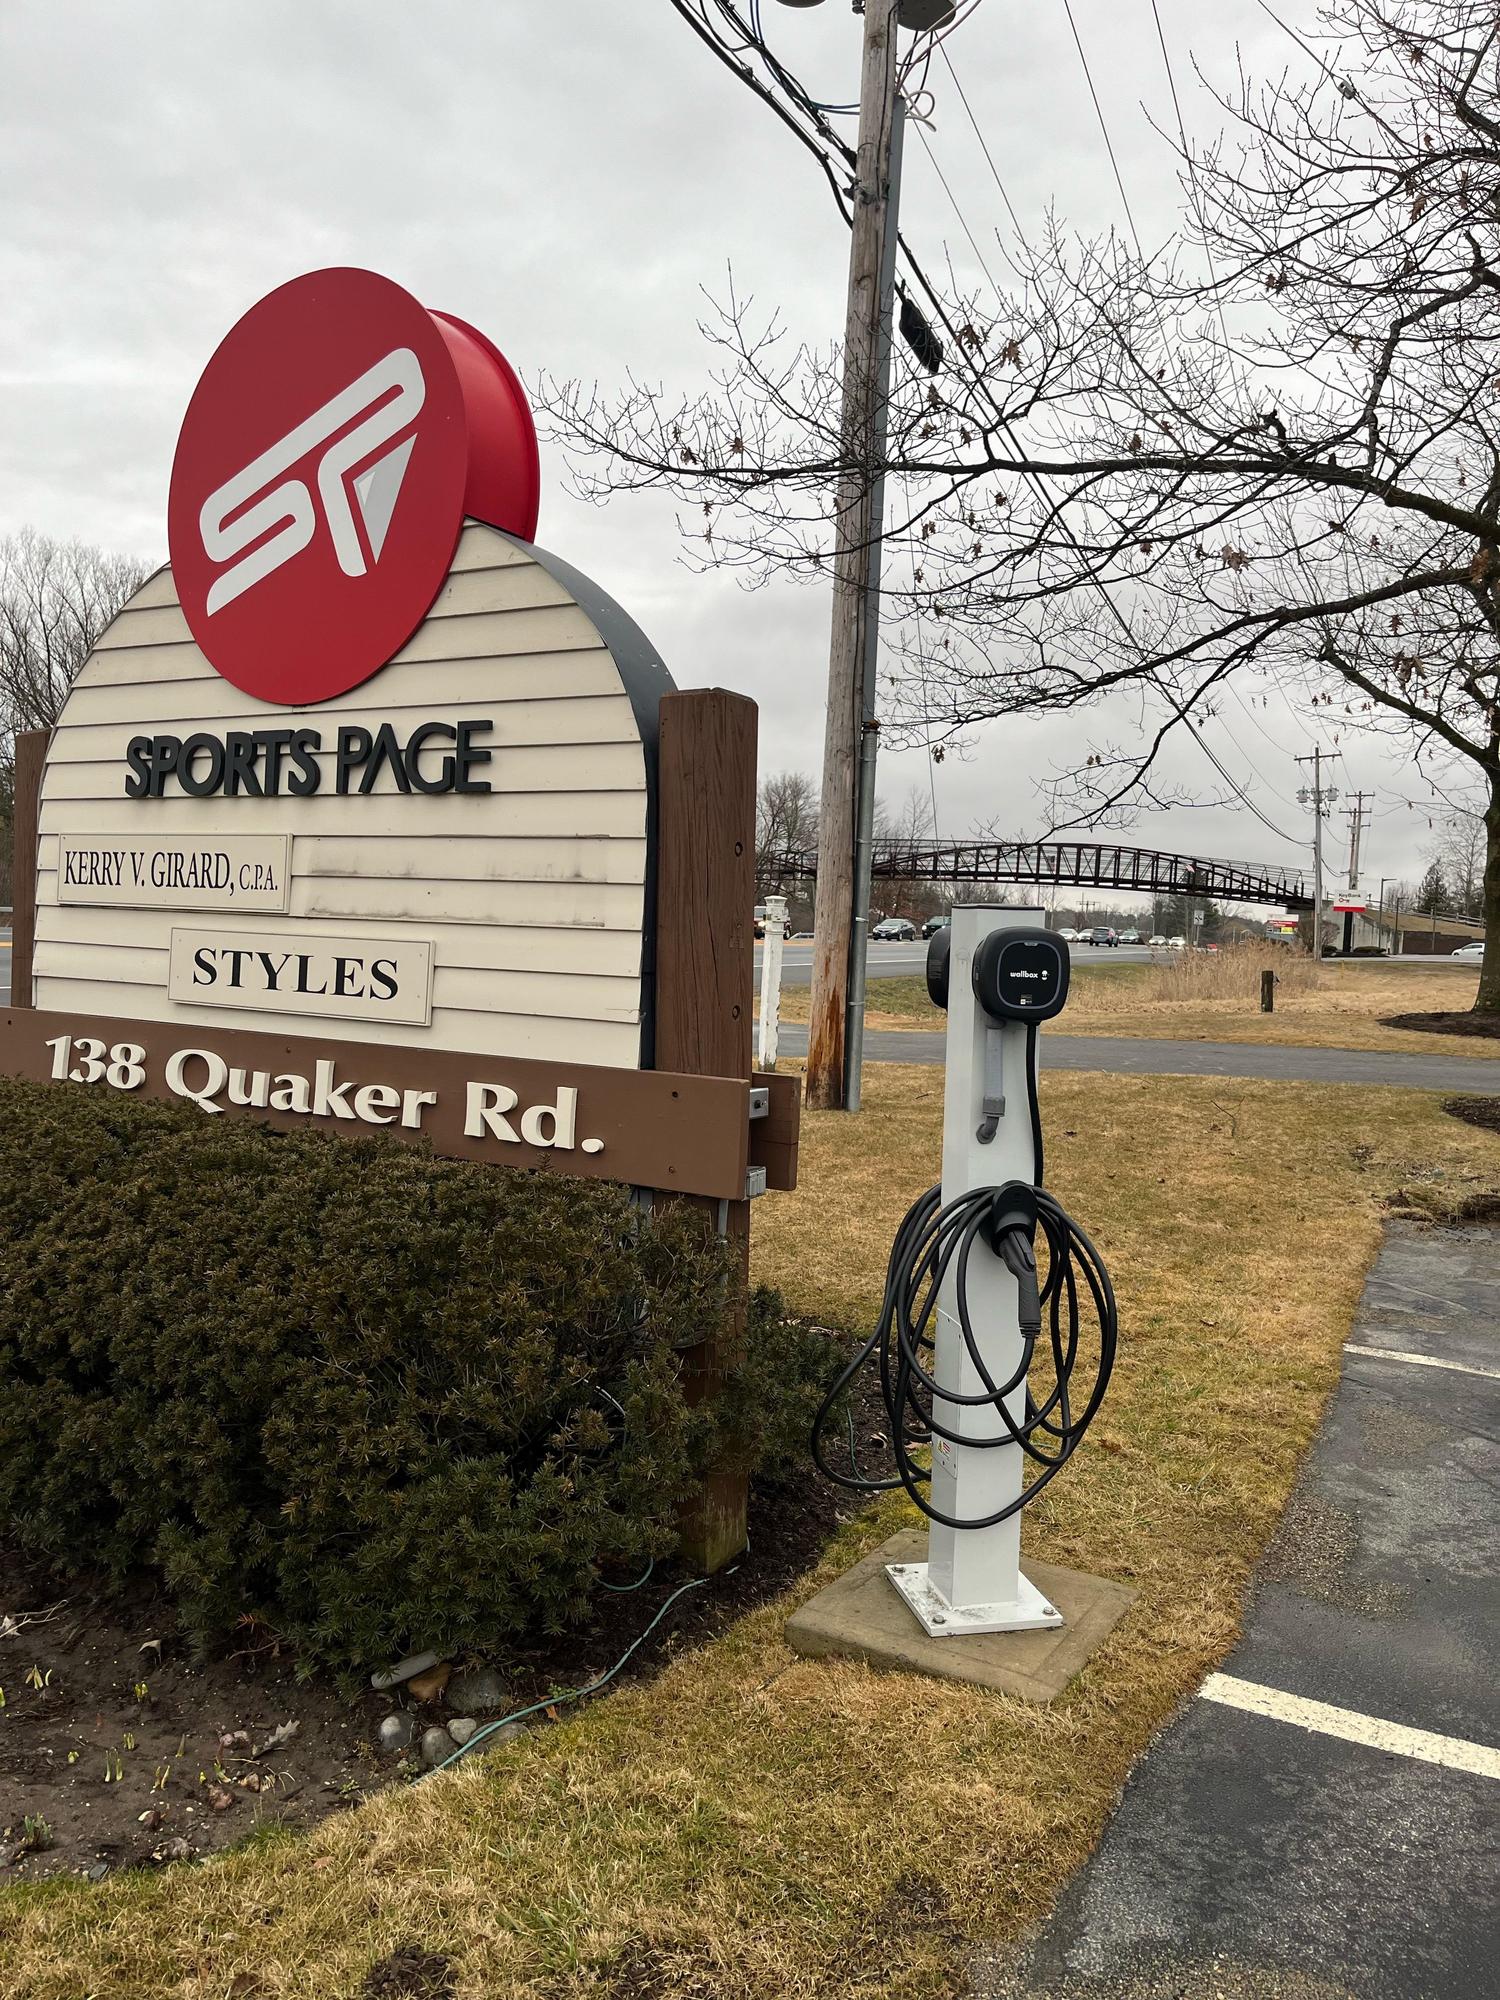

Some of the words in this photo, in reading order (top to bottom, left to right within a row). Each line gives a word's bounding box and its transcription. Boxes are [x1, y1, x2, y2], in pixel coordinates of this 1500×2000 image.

[125, 728, 321, 798] SPORTS
[336, 720, 494, 794] PAGE
[63, 850, 126, 886] KERRY
[130, 851, 145, 887] V.
[151, 851, 235, 896] GIRARD,
[239, 863, 278, 891] C.P.A.
[192, 947, 399, 1000] STYLES
[1010, 970, 1038, 978] wallbox
[44, 1035, 147, 1090] 138
[164, 1048, 437, 1128] Quaker
[463, 1081, 606, 1154] Rd.
